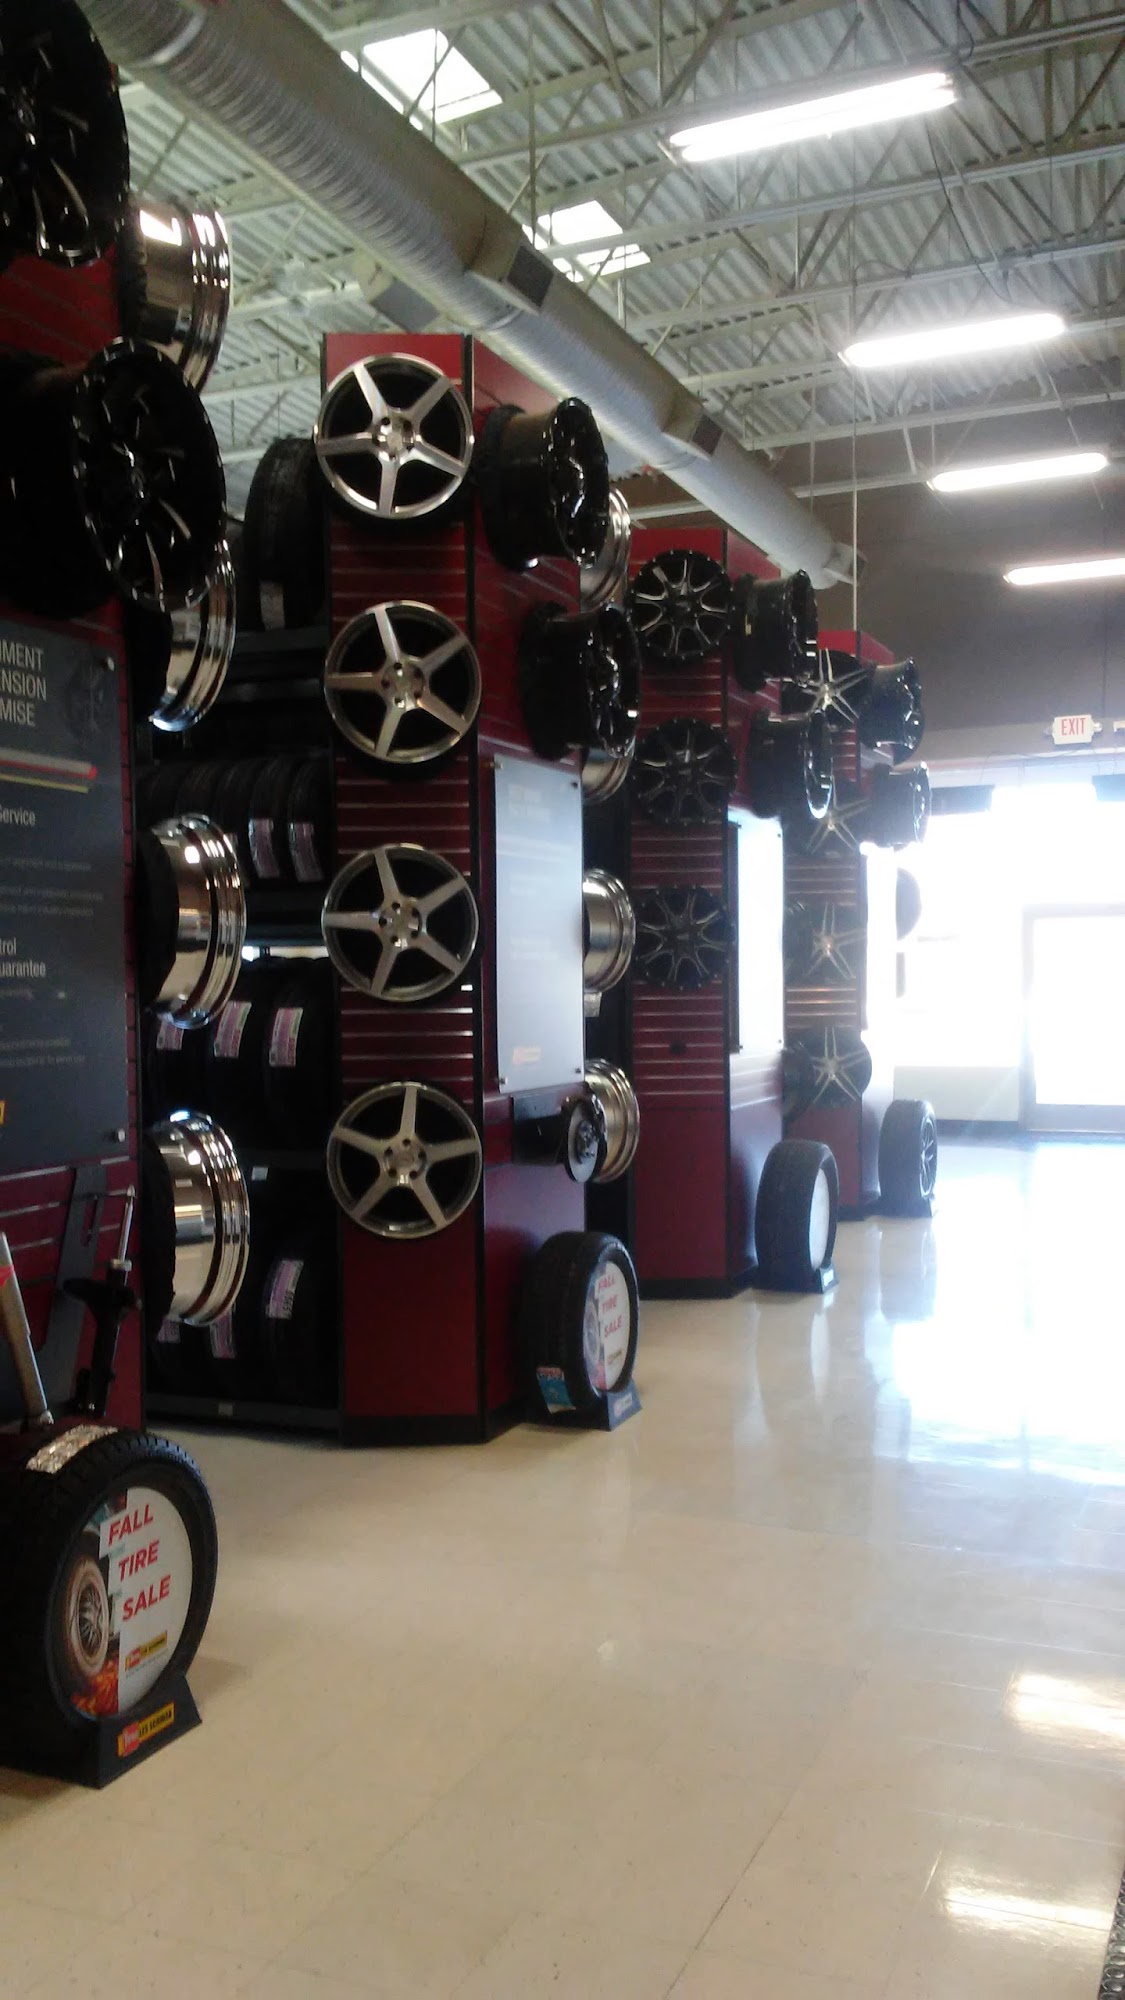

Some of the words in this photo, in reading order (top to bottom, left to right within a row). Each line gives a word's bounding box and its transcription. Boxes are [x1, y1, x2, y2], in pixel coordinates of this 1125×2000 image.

[0, 638, 44, 671] MENT
[1061, 717, 1086, 736] EXIT
[604, 1315, 622, 1338] SALE
[108, 1503, 154, 1547] FALL
[118, 1540, 160, 1582] TIRE
[122, 1574, 171, 1622] SALE
